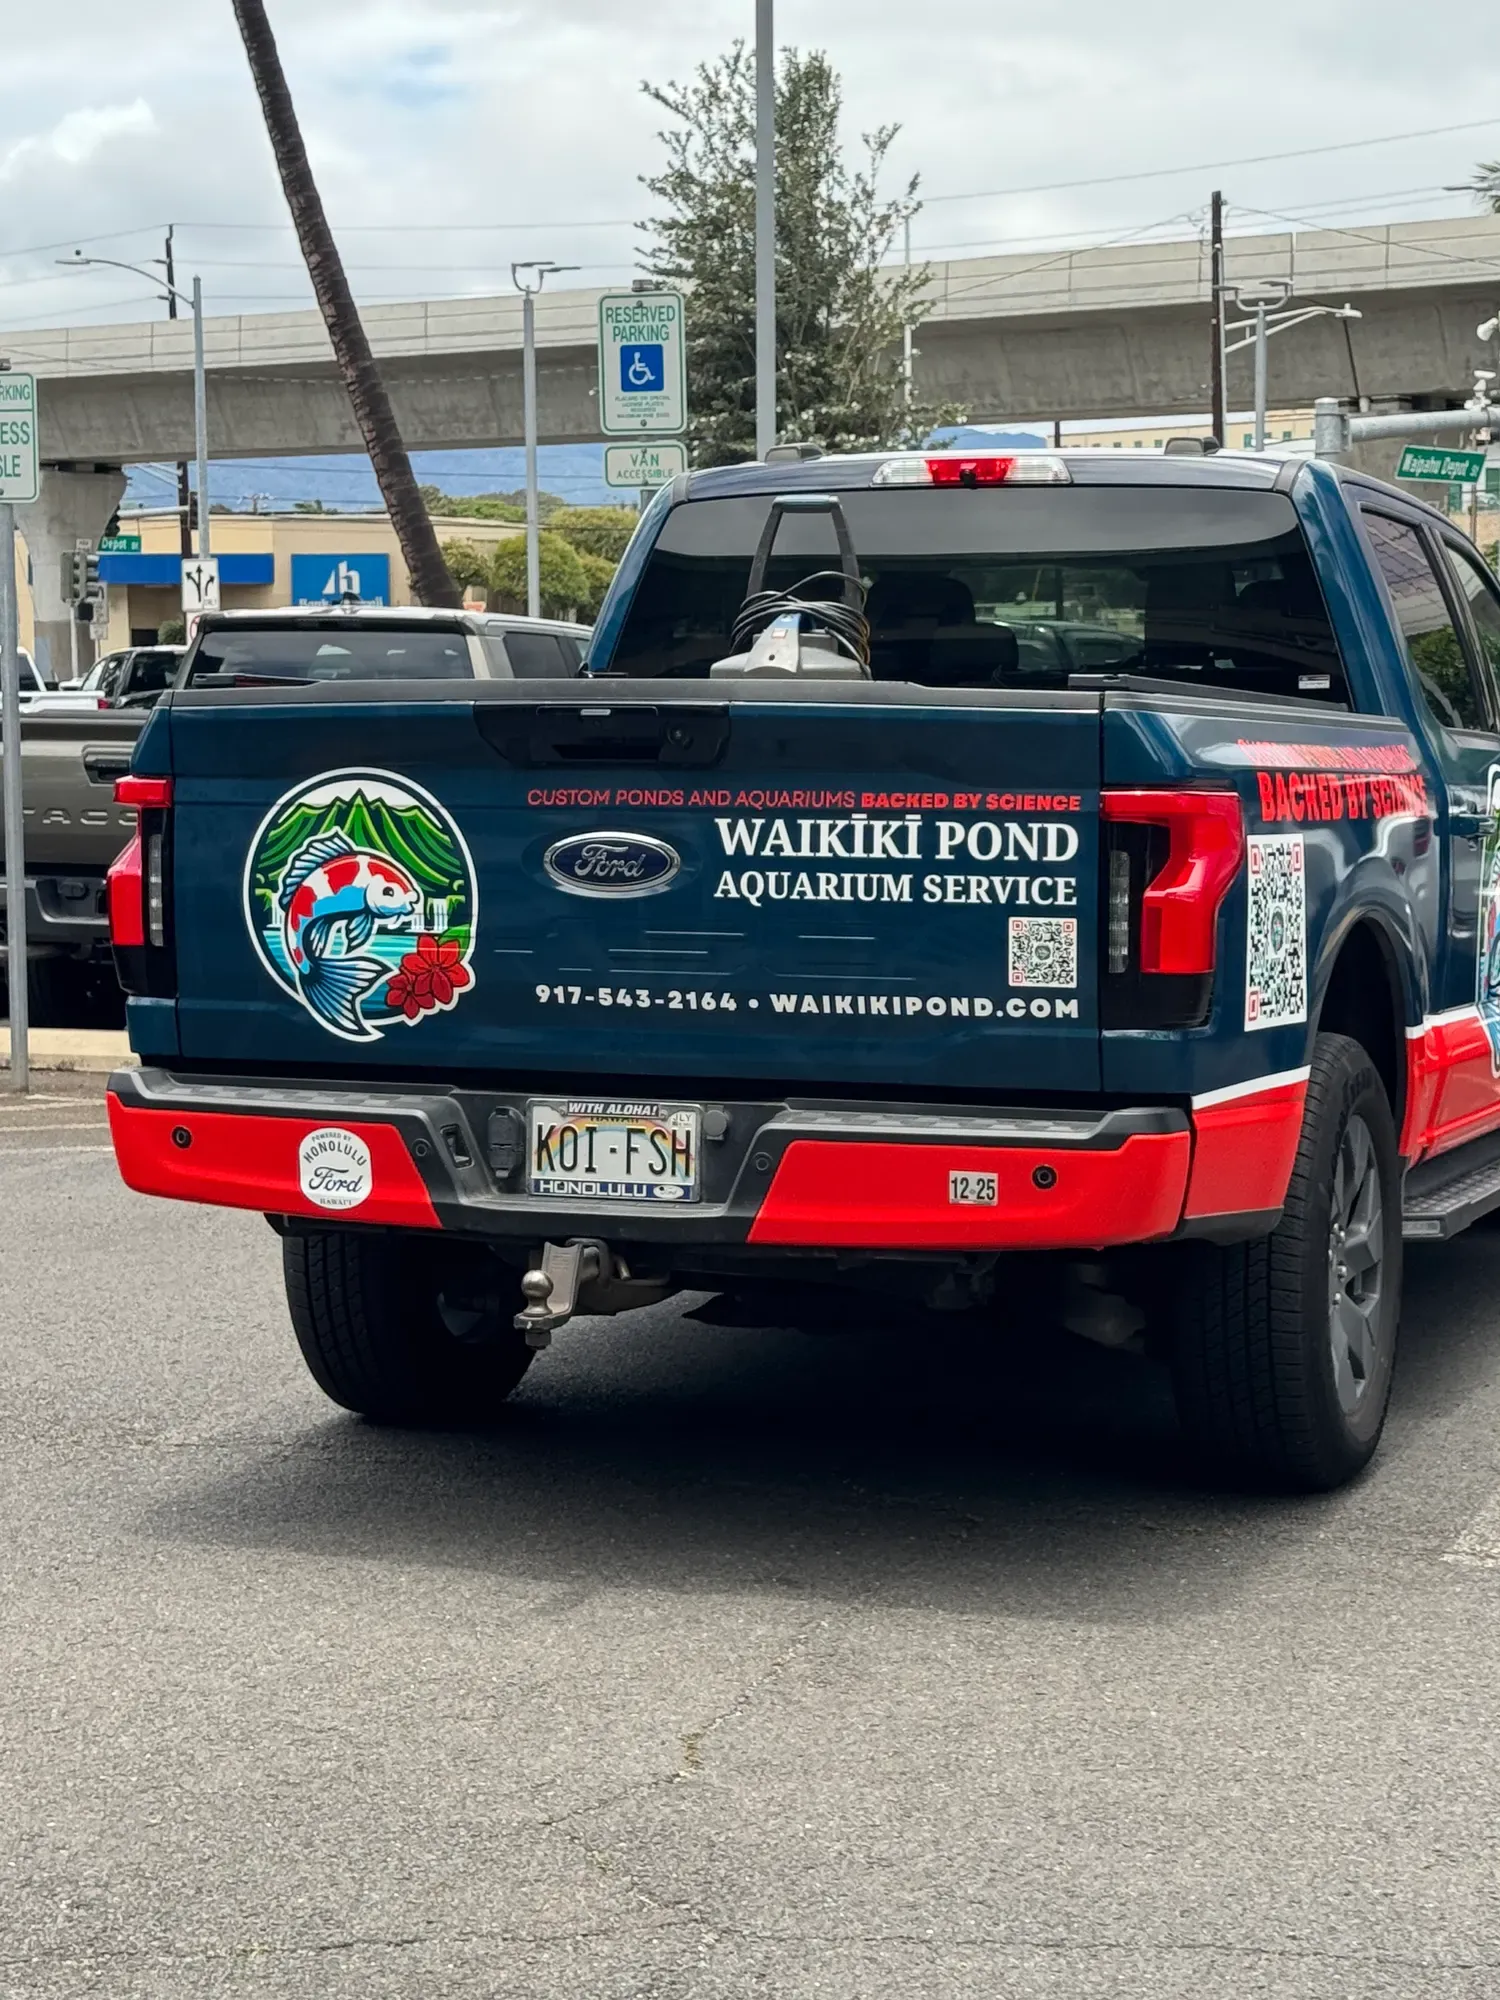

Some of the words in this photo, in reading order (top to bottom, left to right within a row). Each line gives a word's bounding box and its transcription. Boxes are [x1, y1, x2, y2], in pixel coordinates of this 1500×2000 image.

[605, 305, 676, 324] RESERVED
[612, 324, 670, 343] PARKING
[630, 454, 660, 467] VAN
[616, 468, 674, 480] ACCESSIBLE
[101, 537, 127, 552] Depot
[527, 789, 610, 806] CUSTOM
[615, 789, 684, 807] PONDS
[688, 790, 731, 807] AND
[734, 790, 856, 810] AQUARIUMS
[861, 792, 950, 809] BACKED
[953, 792, 983, 809] BY
[985, 793, 1081, 811] SCIENCE
[1256, 771, 1345, 823] BACKED
[714, 813, 923, 860] WAIKĪKĪ
[935, 820, 1080, 862] POND
[573, 843, 646, 877] Ford
[713, 870, 914, 907] AQUARIUM
[922, 874, 1078, 905] SERVICE
[534, 984, 737, 1012] 917-543-2164
[769, 993, 1079, 1019] WAIKIKIPOND.COM
[568, 1102, 604, 1114] WITH
[606, 1103, 658, 1116] ALOHA!
[312, 1132, 342, 1142] POWERED
[343, 1134, 352, 1142] BY
[303, 1140, 368, 1167] HONOLULU
[536, 1123, 692, 1178] KOI-FSH
[308, 1166, 364, 1193] Ford
[539, 1180, 647, 1197] HONOLULU
